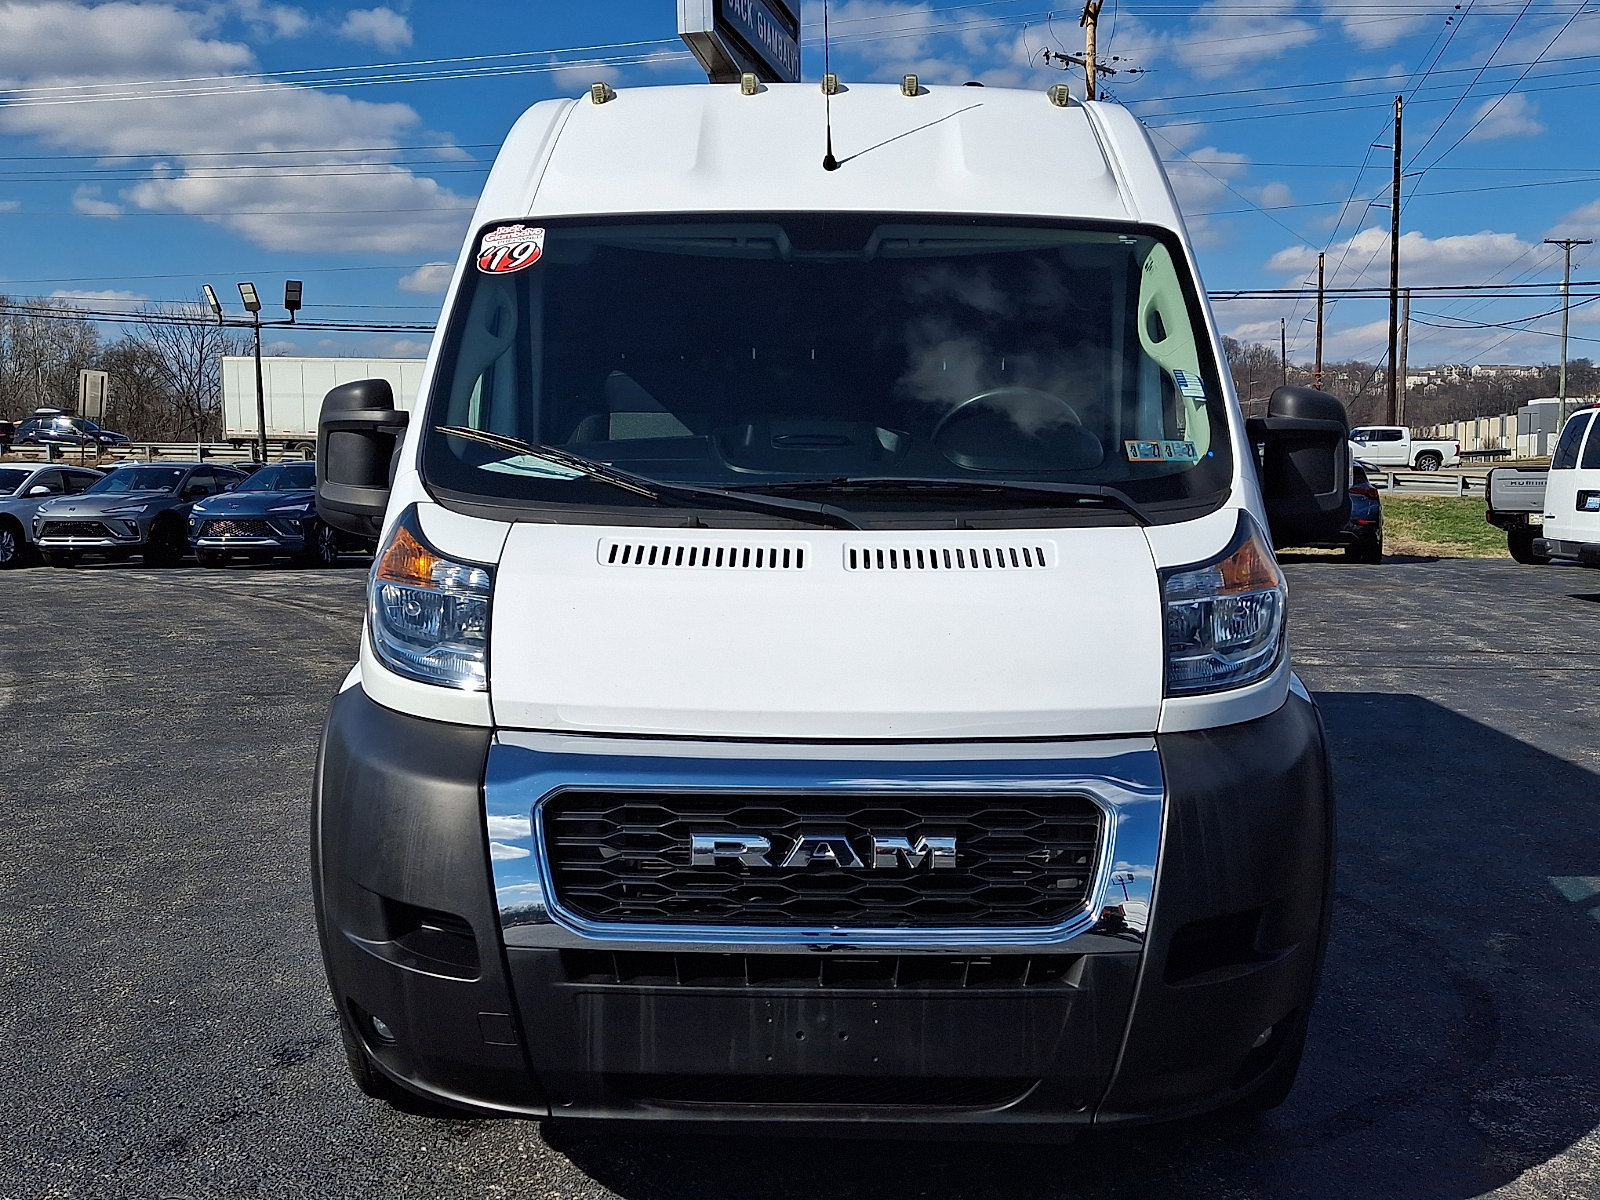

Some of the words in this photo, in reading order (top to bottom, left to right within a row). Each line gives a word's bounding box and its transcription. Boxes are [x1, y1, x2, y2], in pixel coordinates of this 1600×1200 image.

[757, 11, 799, 80] GIAMBALVO
[1130, 445, 1138, 458] 3
[1165, 445, 1173, 458] 3
[690, 833, 957, 869] RAM
